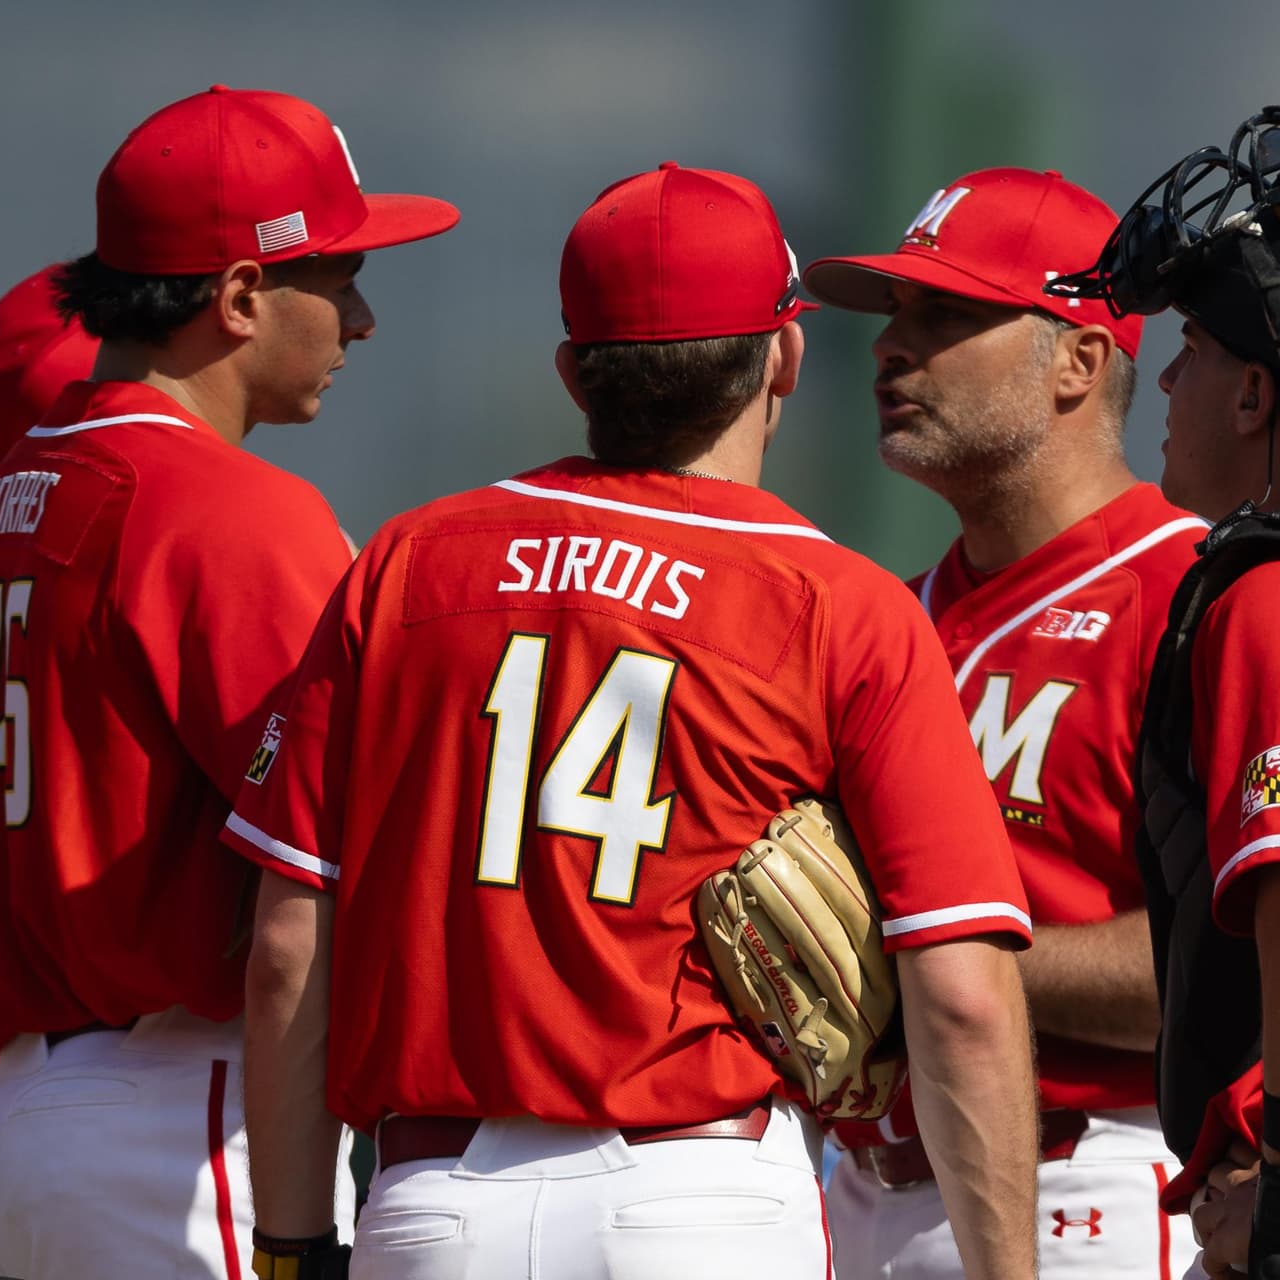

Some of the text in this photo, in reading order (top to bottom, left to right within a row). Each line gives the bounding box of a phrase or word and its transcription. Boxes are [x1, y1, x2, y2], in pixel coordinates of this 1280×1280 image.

[903, 187, 973, 237] M
[498, 535, 705, 620] SIROIS
[475, 630, 680, 907] 14
[969, 671, 1080, 806] M
[744, 920, 758, 940] HE
[752, 939, 773, 966] GOLD
